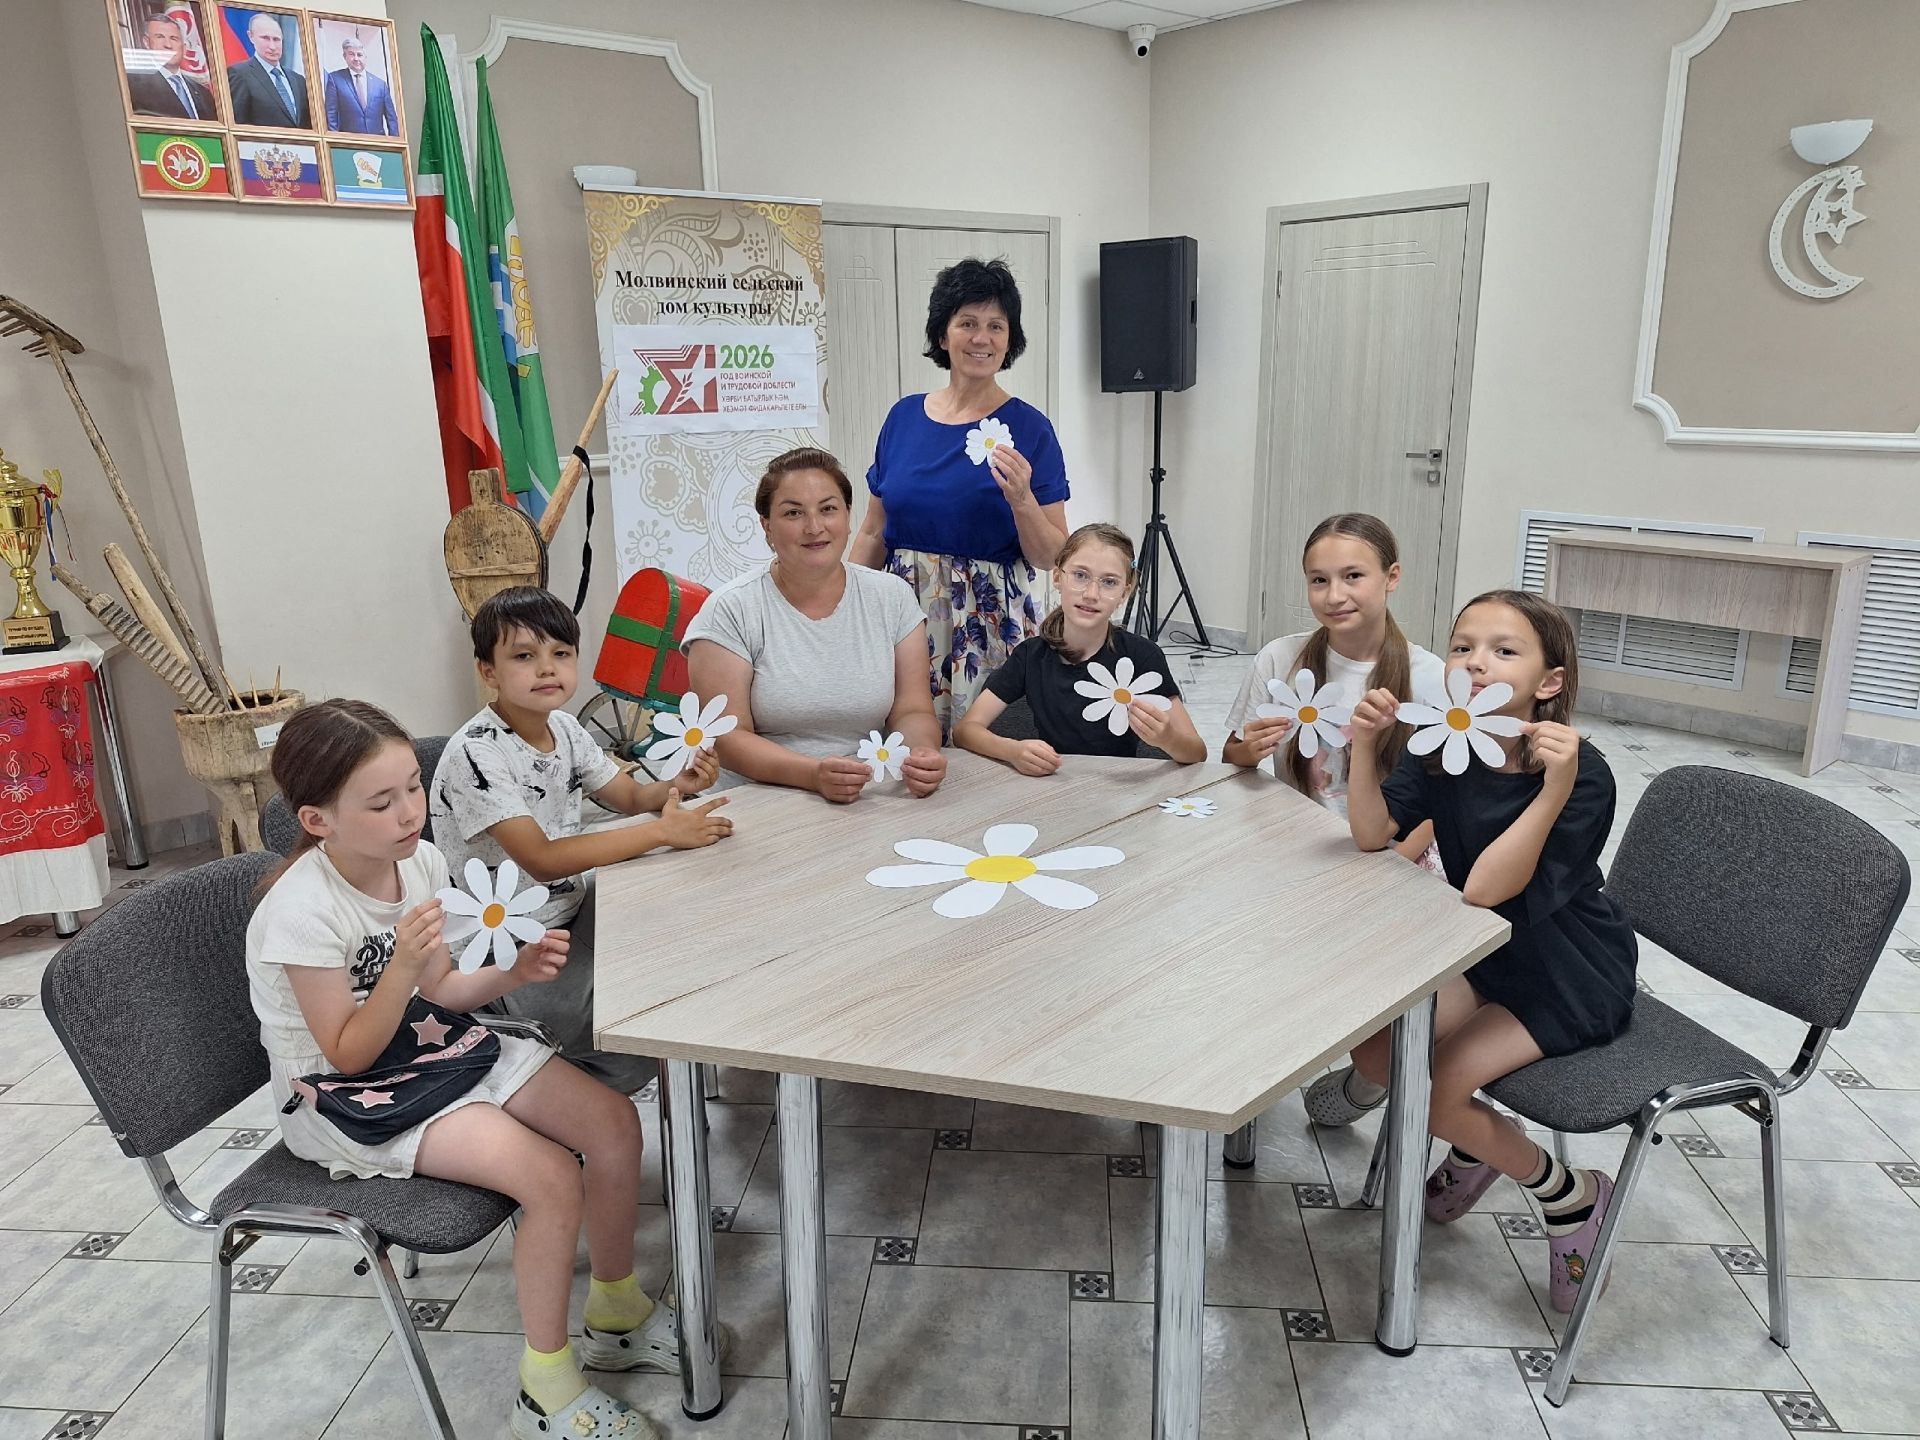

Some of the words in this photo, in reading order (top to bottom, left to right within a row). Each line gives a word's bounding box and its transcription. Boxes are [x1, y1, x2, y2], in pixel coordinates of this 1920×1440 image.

[615, 270, 727, 289] Молвинский
[732, 275, 804, 291] сельский
[656, 301, 688, 315] дом
[693, 302, 772, 319] культуры
[720, 344, 775, 369] 2026
[720, 372, 734, 380] ГОД
[735, 370, 772, 380] ВОИНСКОЙ
[727, 381, 762, 391] ТРУДОВОЙ
[763, 381, 796, 390] ДОБЛЕСТИ
